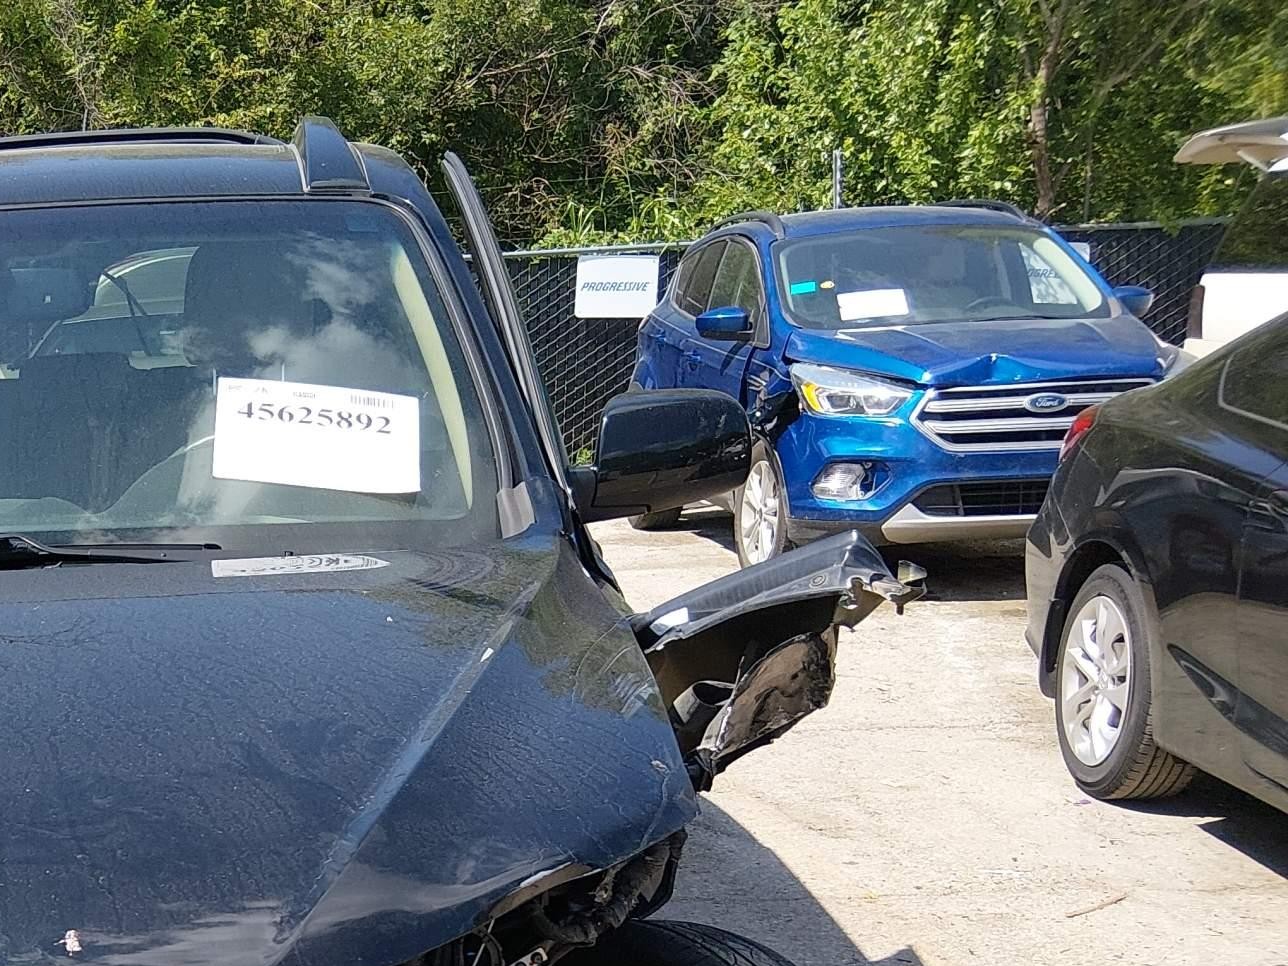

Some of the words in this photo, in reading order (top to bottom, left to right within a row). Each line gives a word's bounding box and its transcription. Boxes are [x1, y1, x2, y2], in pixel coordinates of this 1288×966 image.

[580, 281, 650, 292] PROGRESSIVE
[1035, 397, 1061, 408] Ford
[237, 401, 392, 435] 45625892
